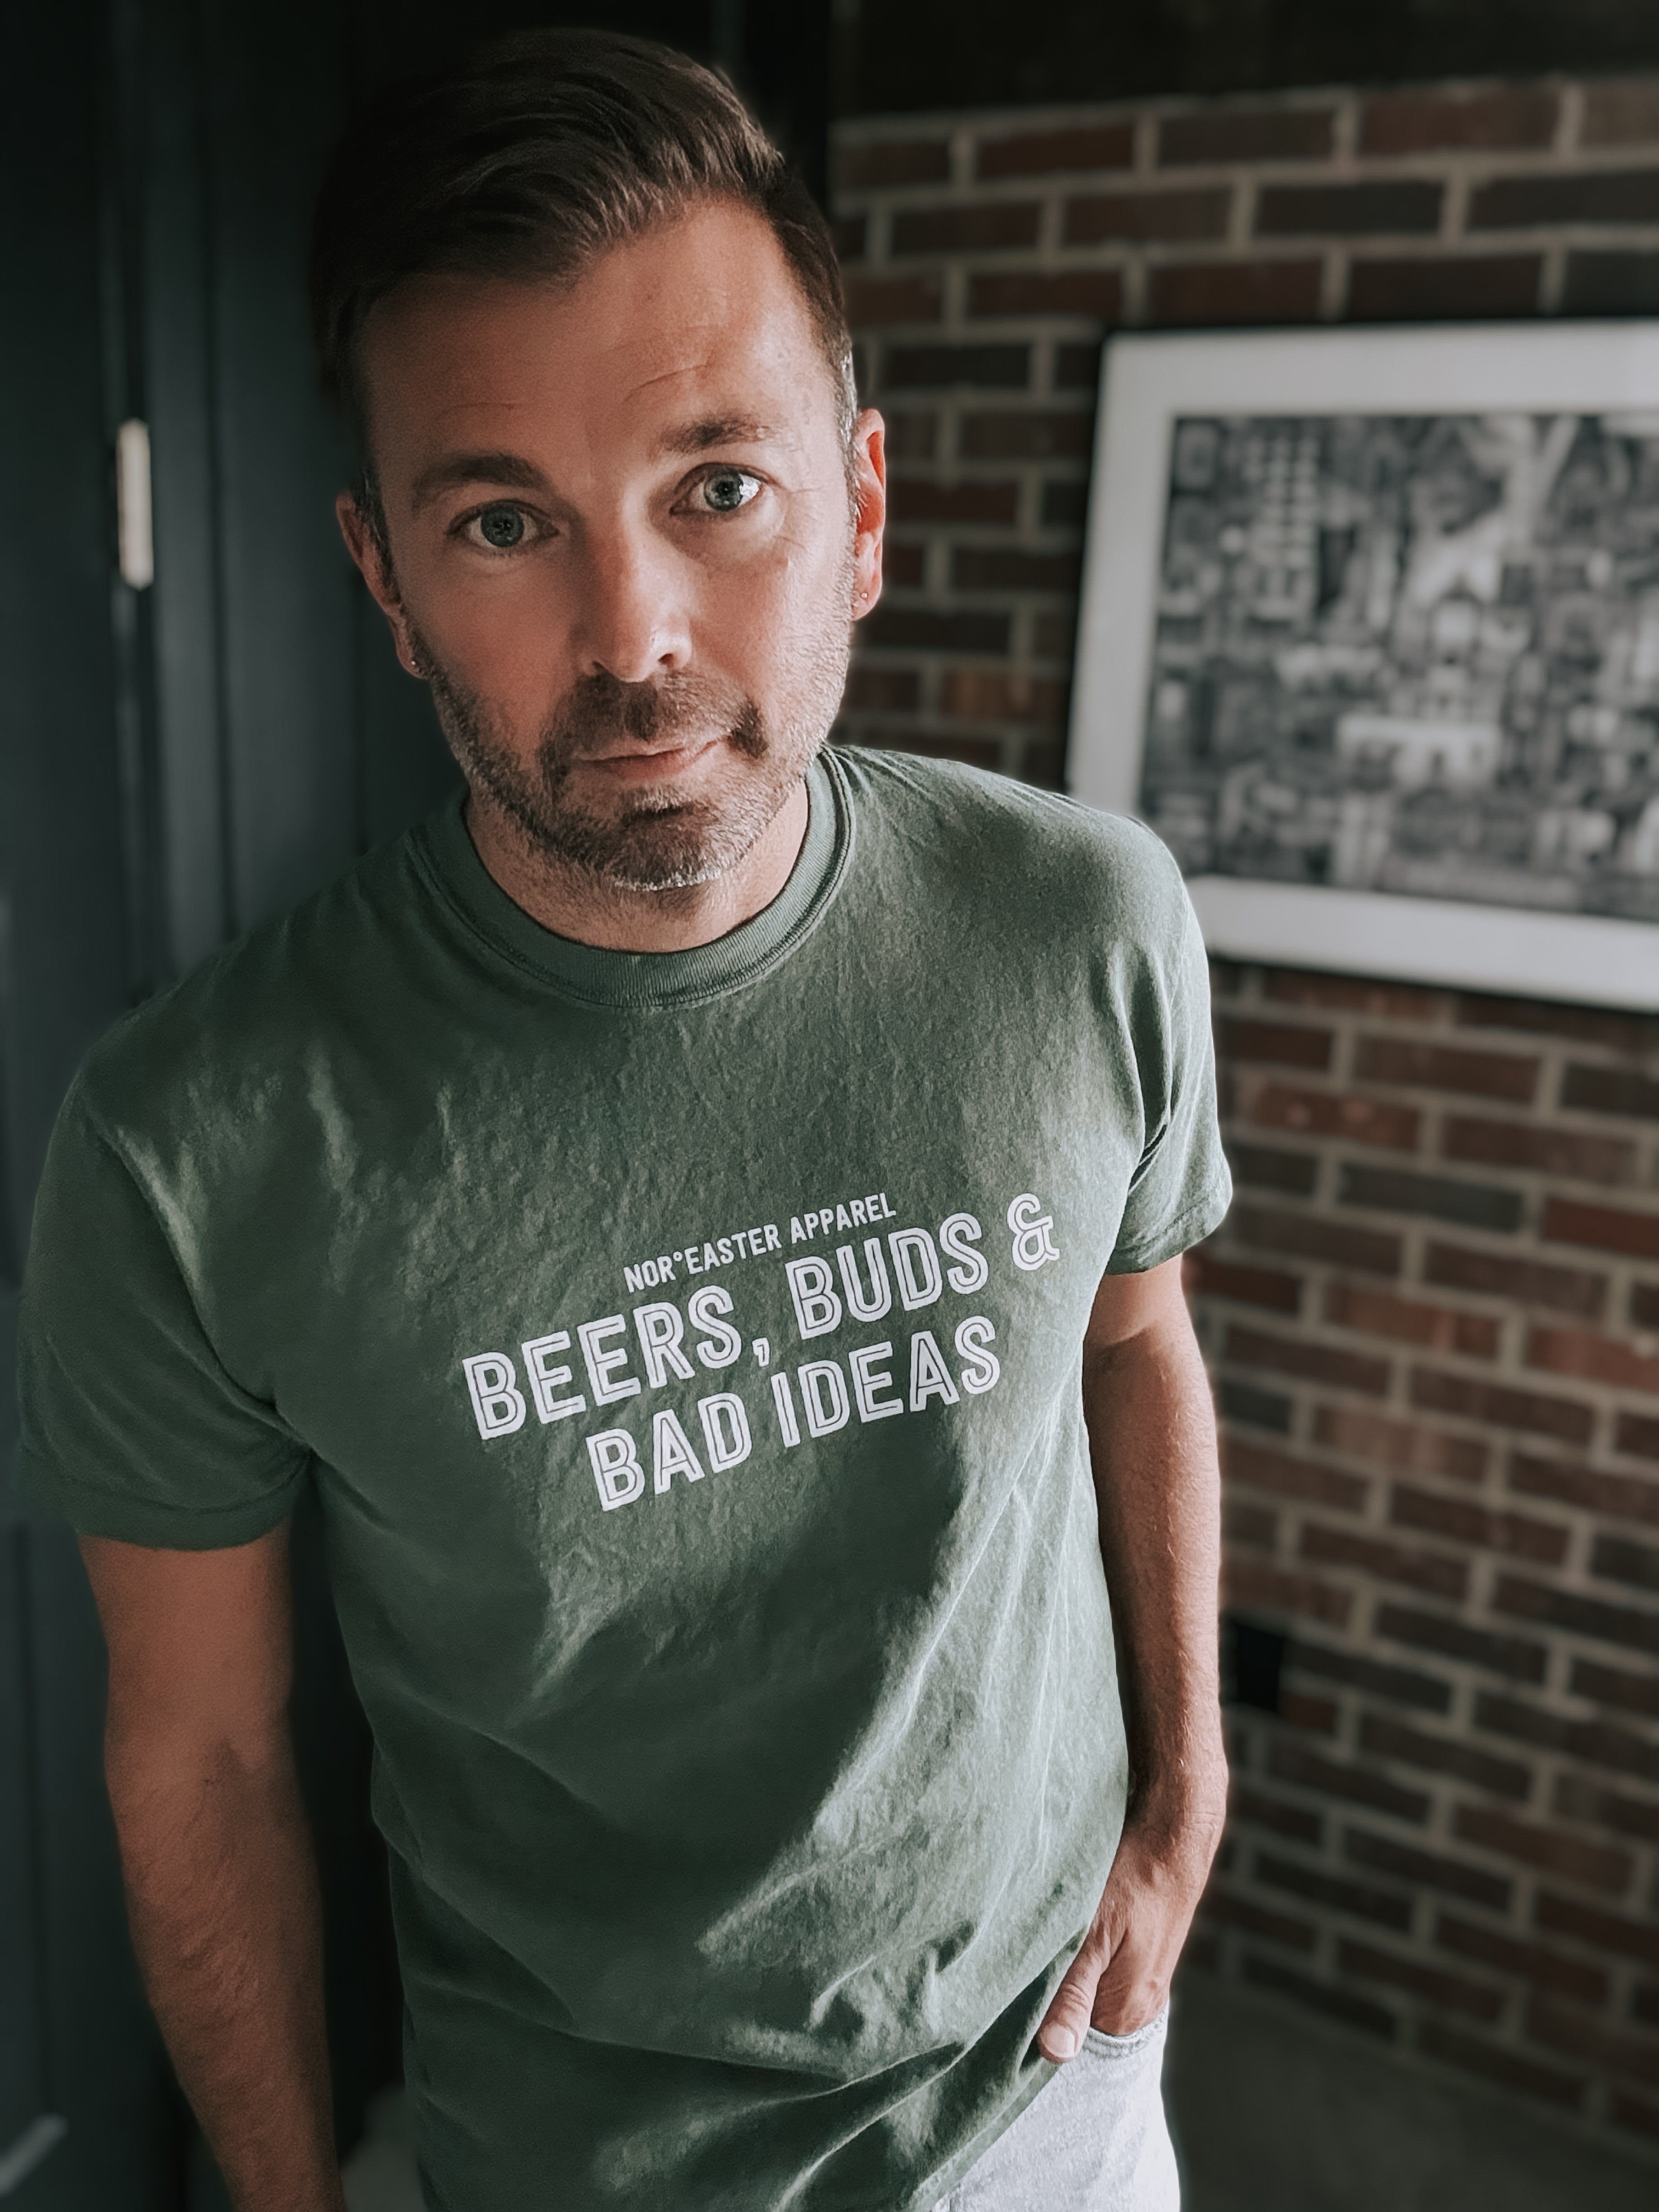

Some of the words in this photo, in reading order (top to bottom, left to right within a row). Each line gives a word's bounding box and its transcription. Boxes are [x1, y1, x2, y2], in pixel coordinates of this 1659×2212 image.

[462, 1285, 771, 1440] BEERS,
[785, 1212, 989, 1339] BUDS
[1007, 1192, 1060, 1271] &
[790, 1192, 897, 1244] APPAREL
[585, 1392, 752, 1511] BAD
[771, 1315, 1001, 1448] IDEAS
